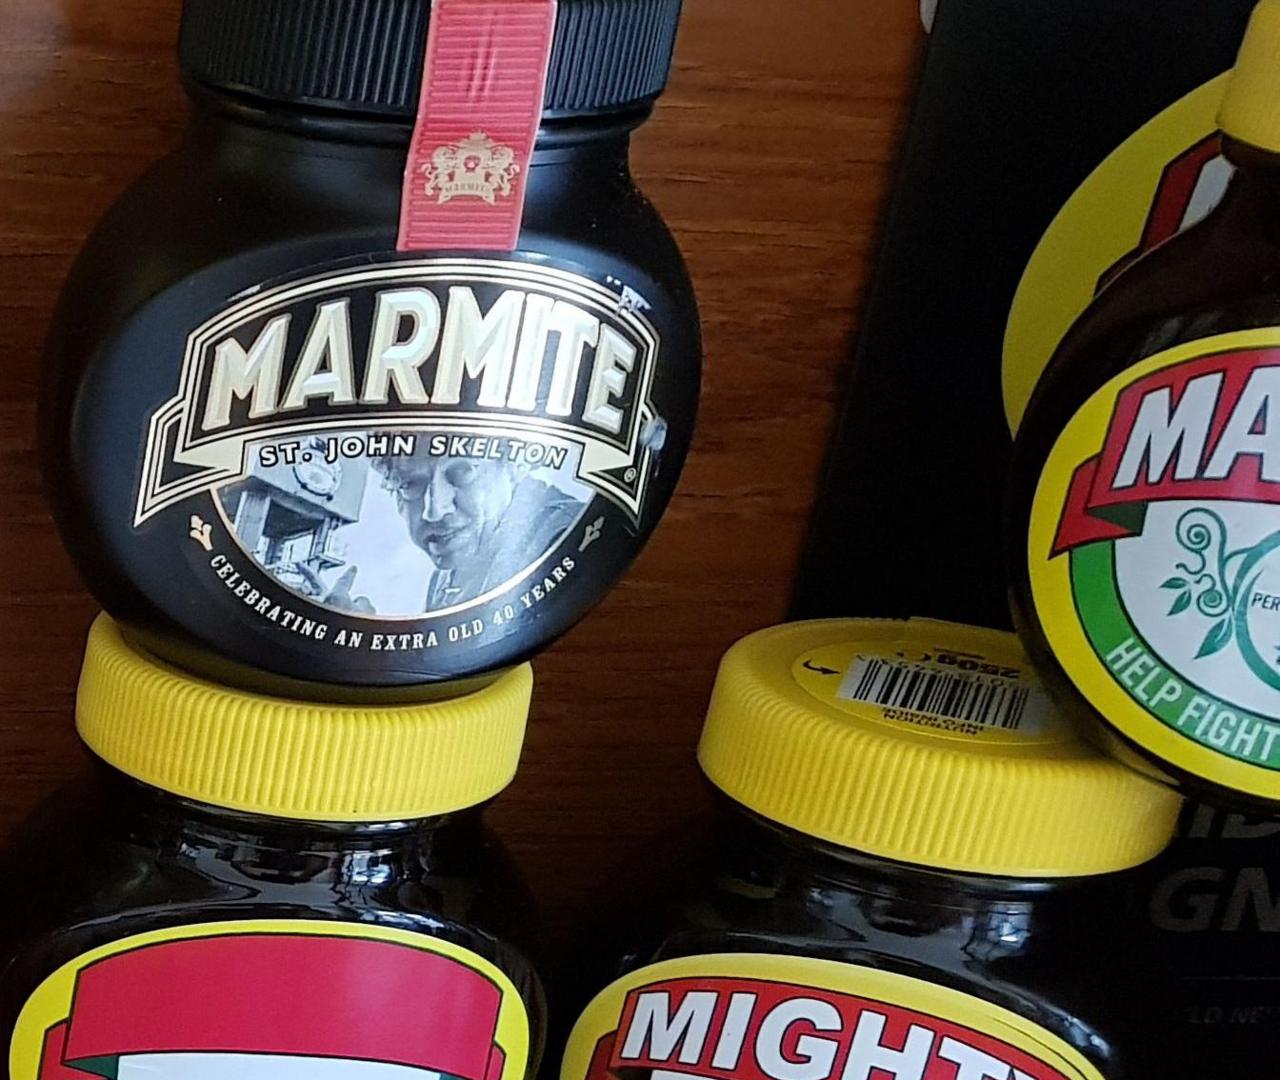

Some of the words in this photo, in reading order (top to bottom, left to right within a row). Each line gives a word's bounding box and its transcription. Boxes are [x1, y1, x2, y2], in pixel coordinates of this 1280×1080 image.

[200, 285, 637, 433] MARMITE
[259, 441, 316, 467] ST.
[324, 434, 416, 464] JOHN
[430, 436, 567, 468] SKELTON
[211, 554, 329, 641] CELEBRATING
[335, 627, 363, 649] AN
[370, 631, 439, 651] EXTRA
[448, 620, 485, 643] OLD
[491, 604, 516, 627] 40
[518, 555, 579, 610] YEARS
[1106, 637, 1183, 709] HELP
[1178, 700, 1280, 762] FIGHT
